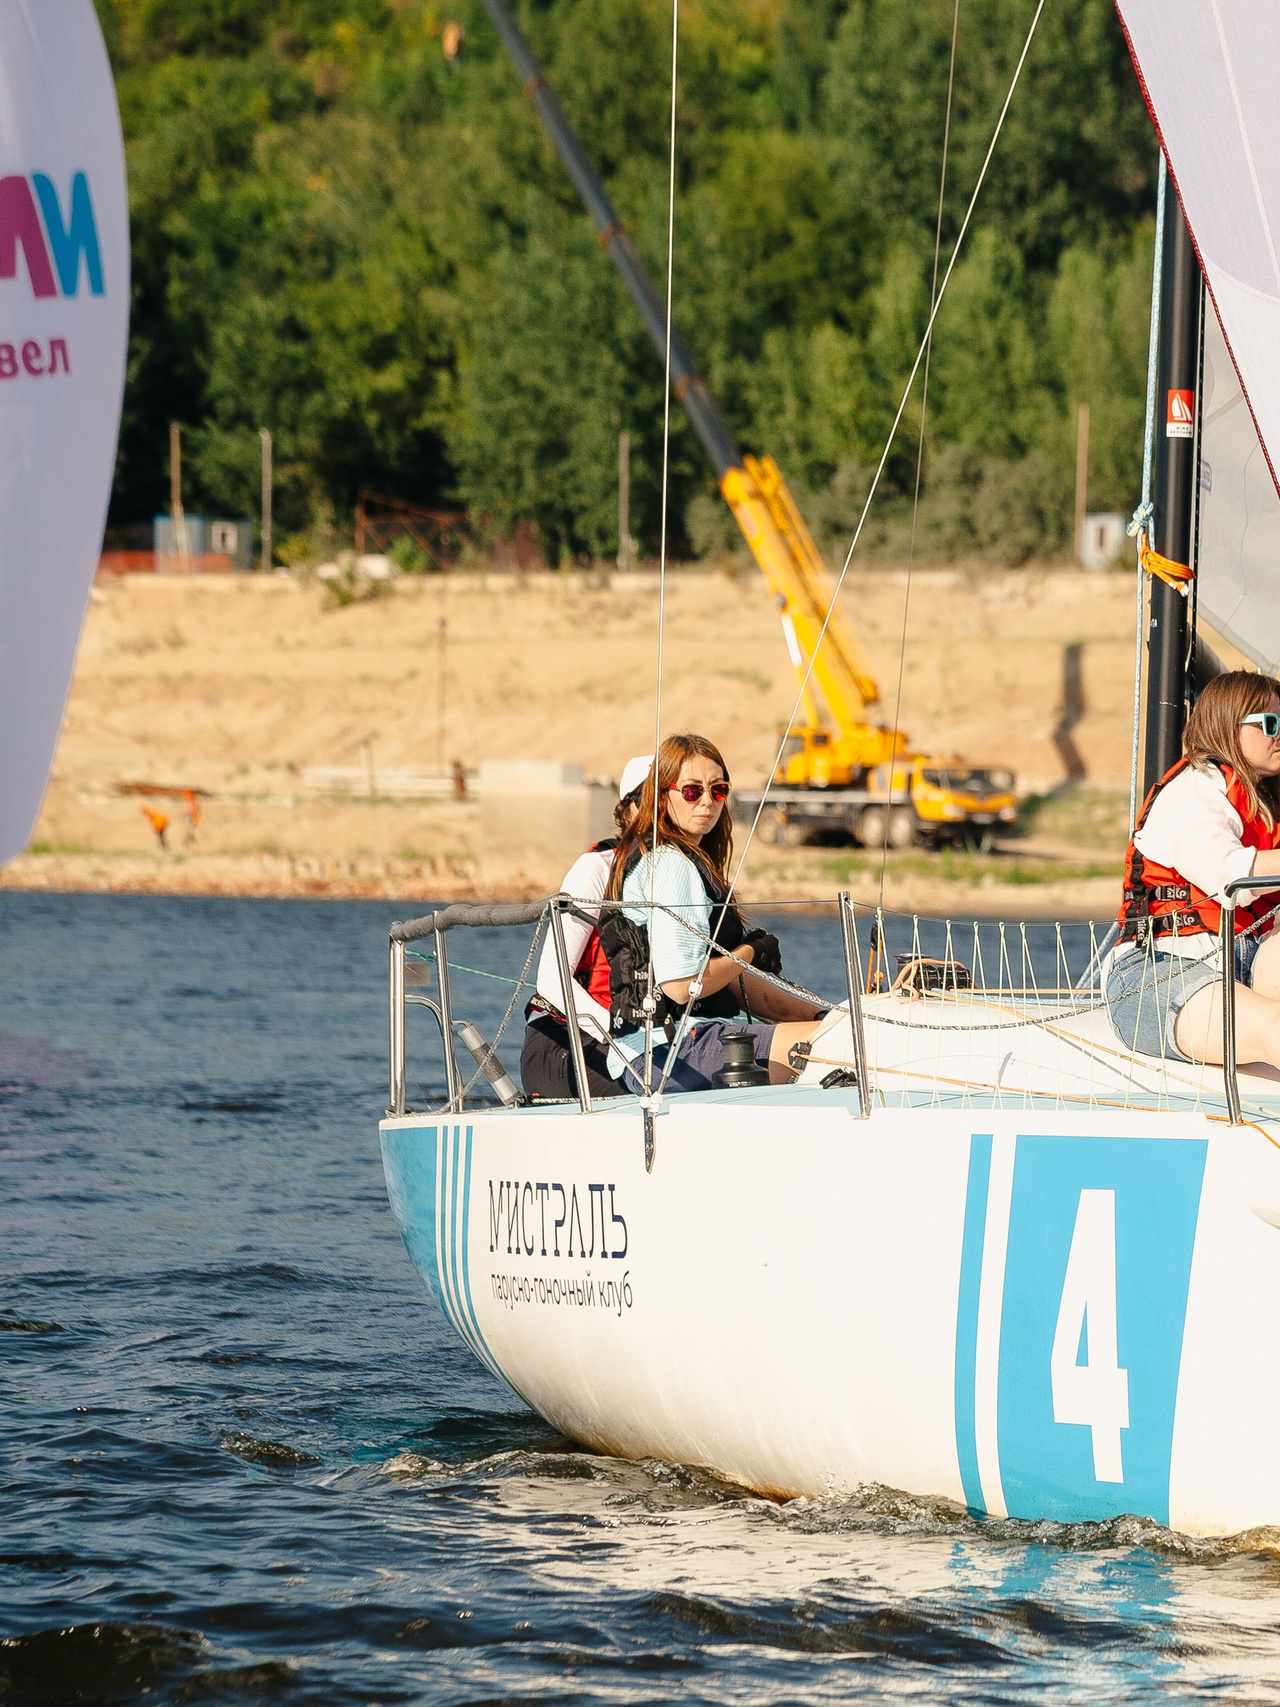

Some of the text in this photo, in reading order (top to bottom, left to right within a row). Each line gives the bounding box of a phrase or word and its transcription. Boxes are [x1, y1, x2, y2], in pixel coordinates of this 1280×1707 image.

[634, 970, 649, 980] hik
[632, 1008, 649, 1018] hik
[488, 1180, 628, 1259] МИСТРАЛЬ
[491, 1270, 633, 1317] парусно-гоночный клуб
[1050, 1188, 1130, 1484] 4
